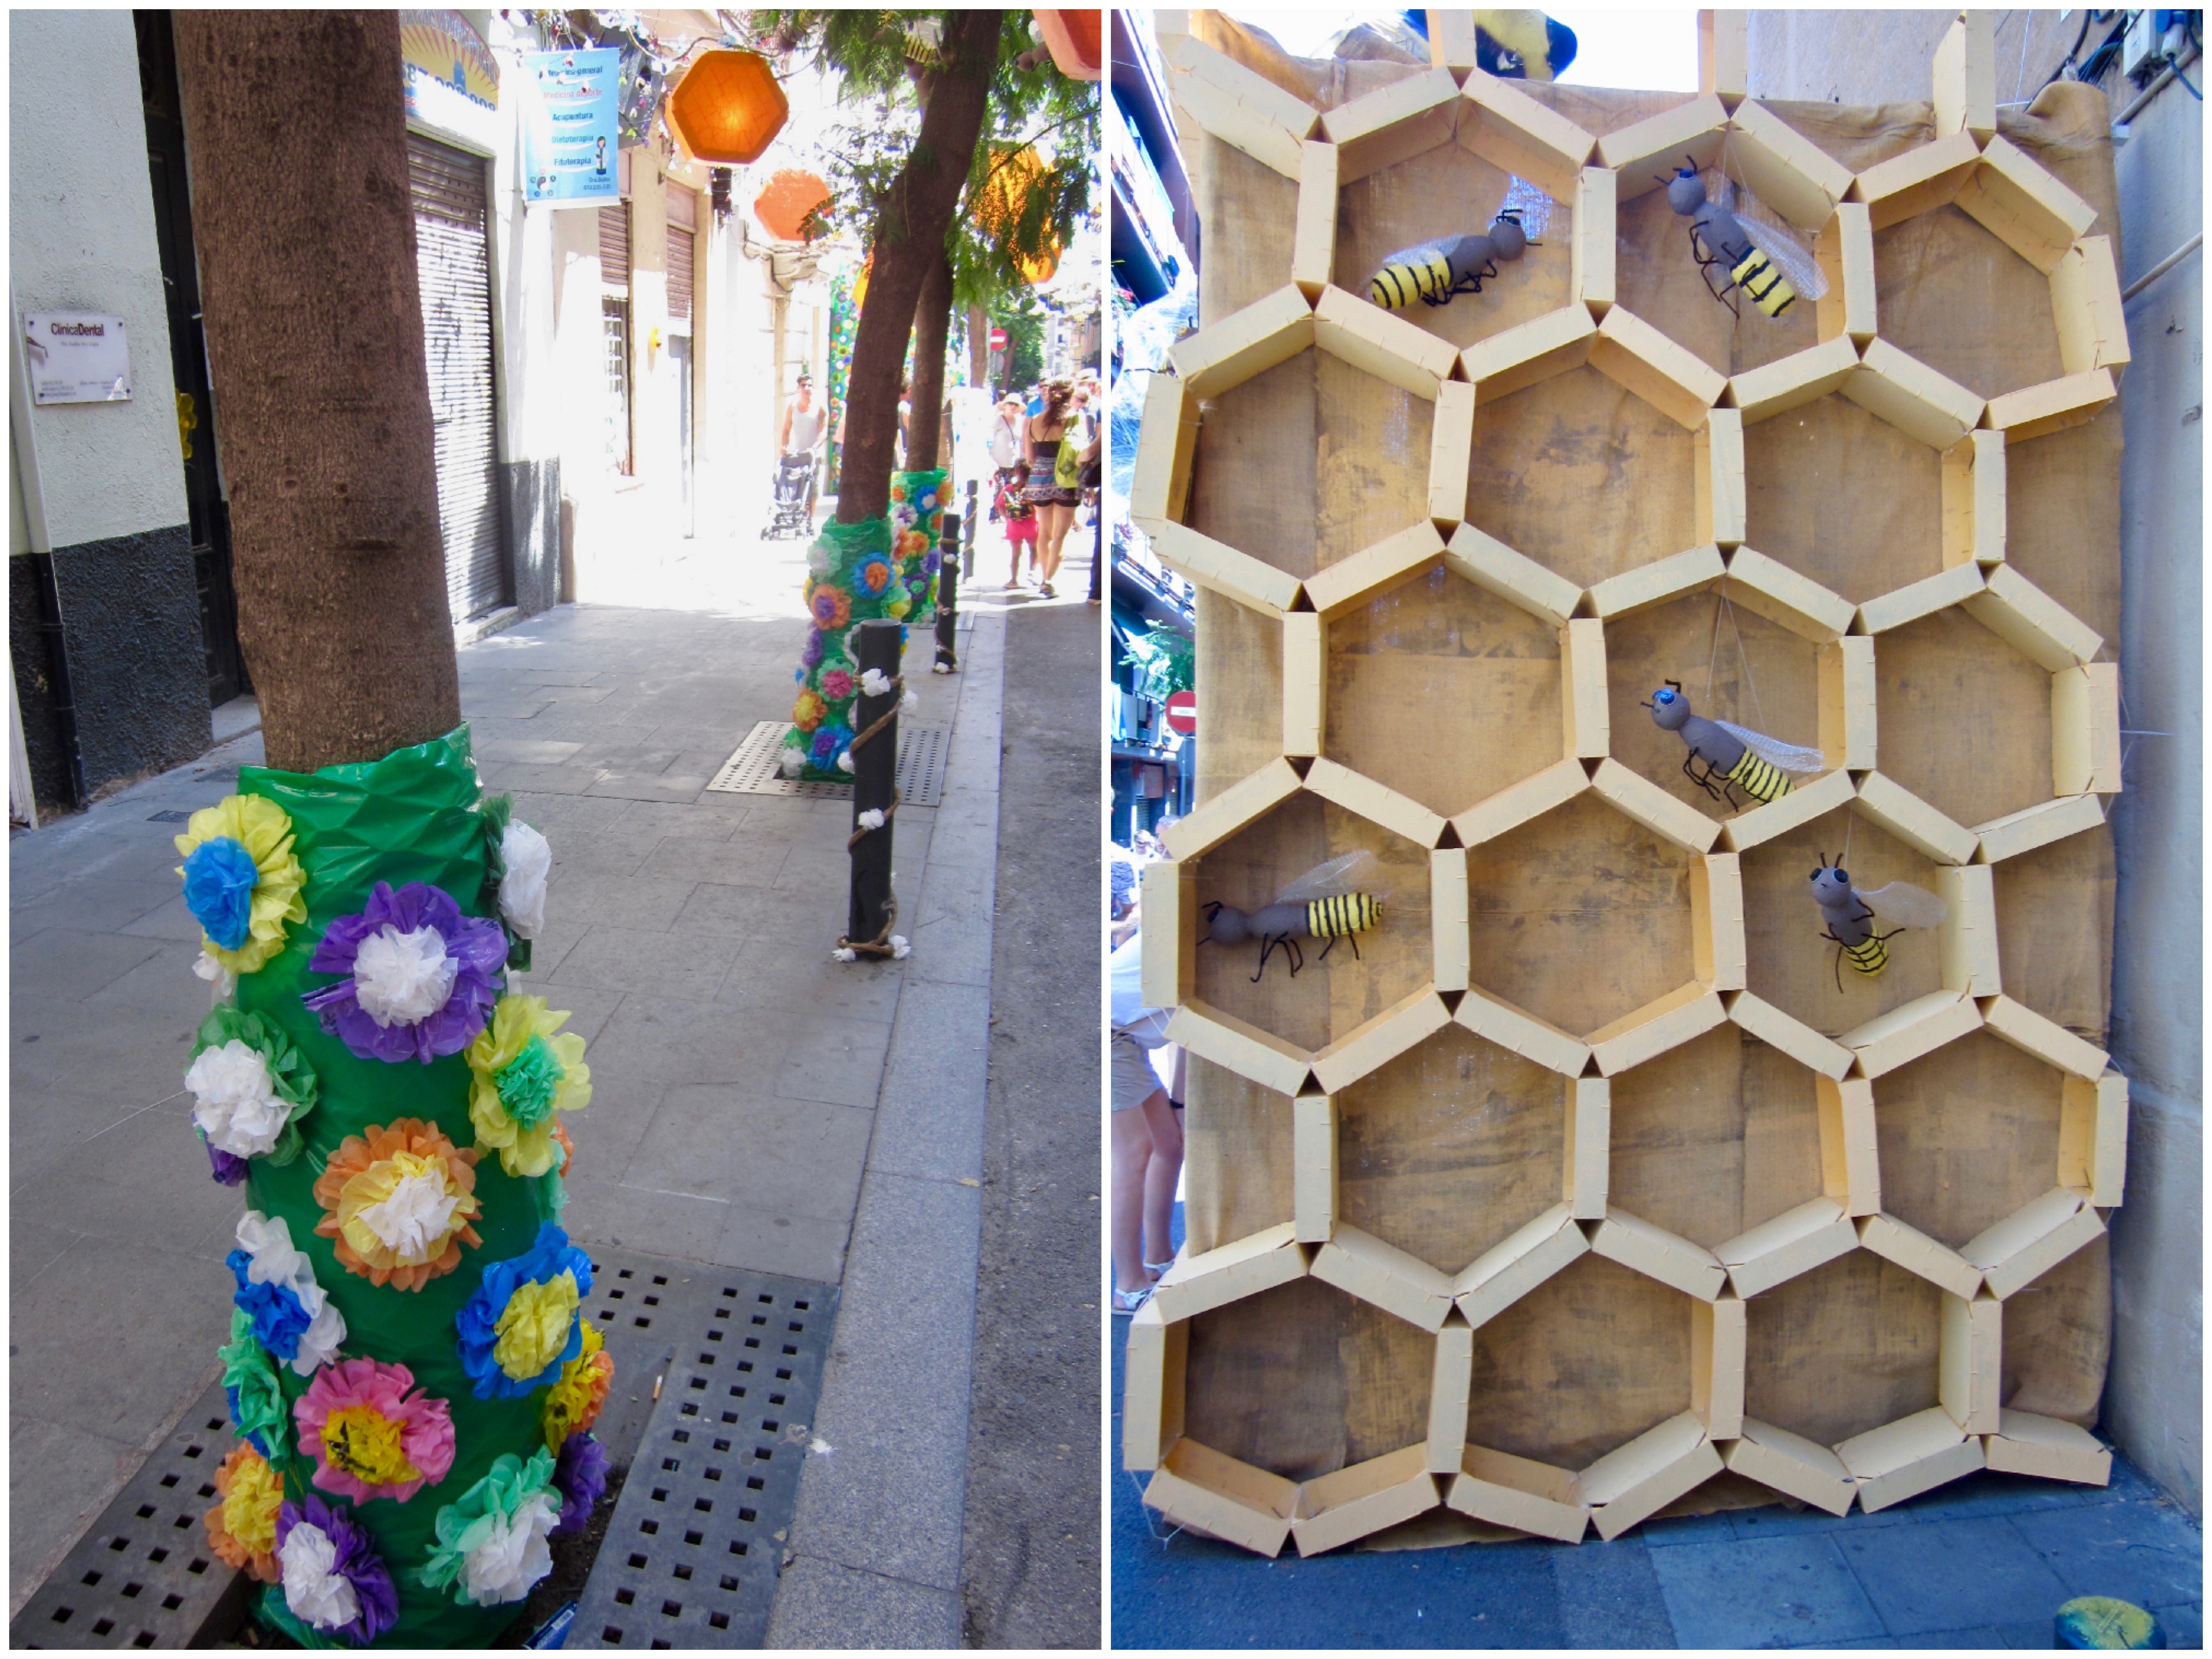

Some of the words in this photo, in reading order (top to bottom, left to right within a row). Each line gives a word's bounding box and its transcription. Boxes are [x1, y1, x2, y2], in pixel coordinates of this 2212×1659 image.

[577, 65, 603, 76] general
[544, 90, 575, 99] Medicina
[552, 112, 594, 122] Acupuntura
[551, 135, 594, 143] Dietoterapia
[554, 157, 592, 166] Fitoterapia
